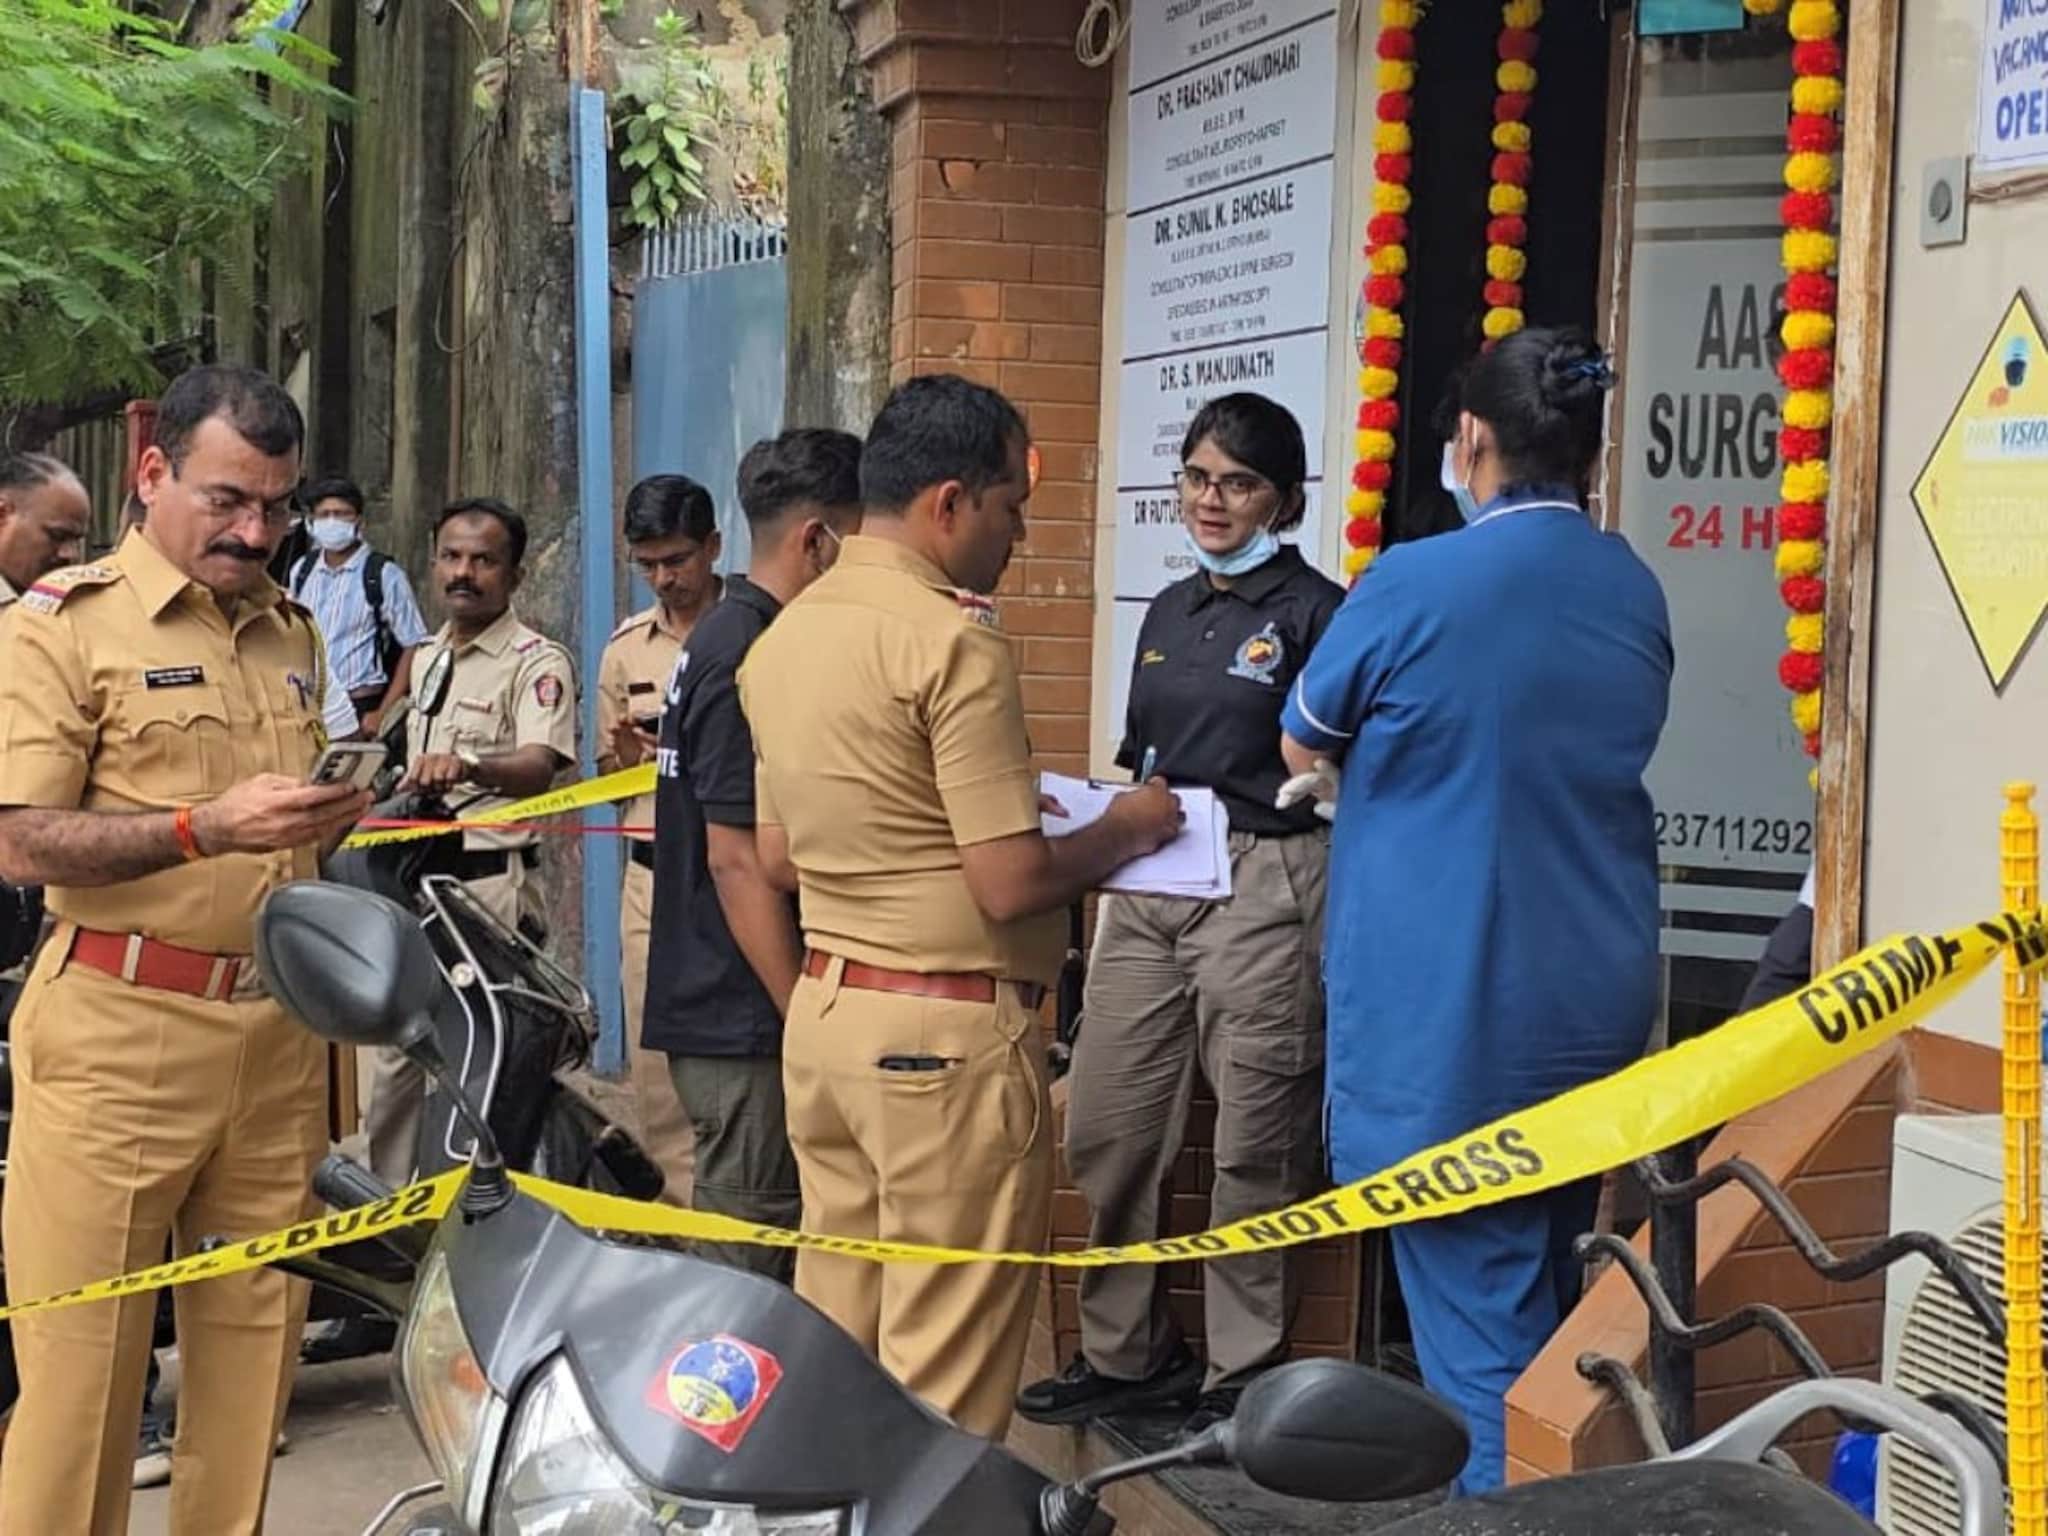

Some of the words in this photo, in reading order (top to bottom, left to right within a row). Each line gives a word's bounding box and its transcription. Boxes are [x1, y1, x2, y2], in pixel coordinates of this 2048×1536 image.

[1234, 40, 1300, 91] CHAUDHARI
[1996, 88, 2048, 140] OPE
[1177, 206, 1212, 239] SUNIL
[1232, 182, 1294, 225] BHOSALE
[1196, 348, 1275, 385] MANJUNATH
[1646, 392, 1778, 480] SURG
[1667, 504, 1725, 549] 24
[1654, 812, 1813, 855] 23711292
[1243, 1198, 1351, 1245] NOT
[1360, 1127, 1544, 1217] CROSS
